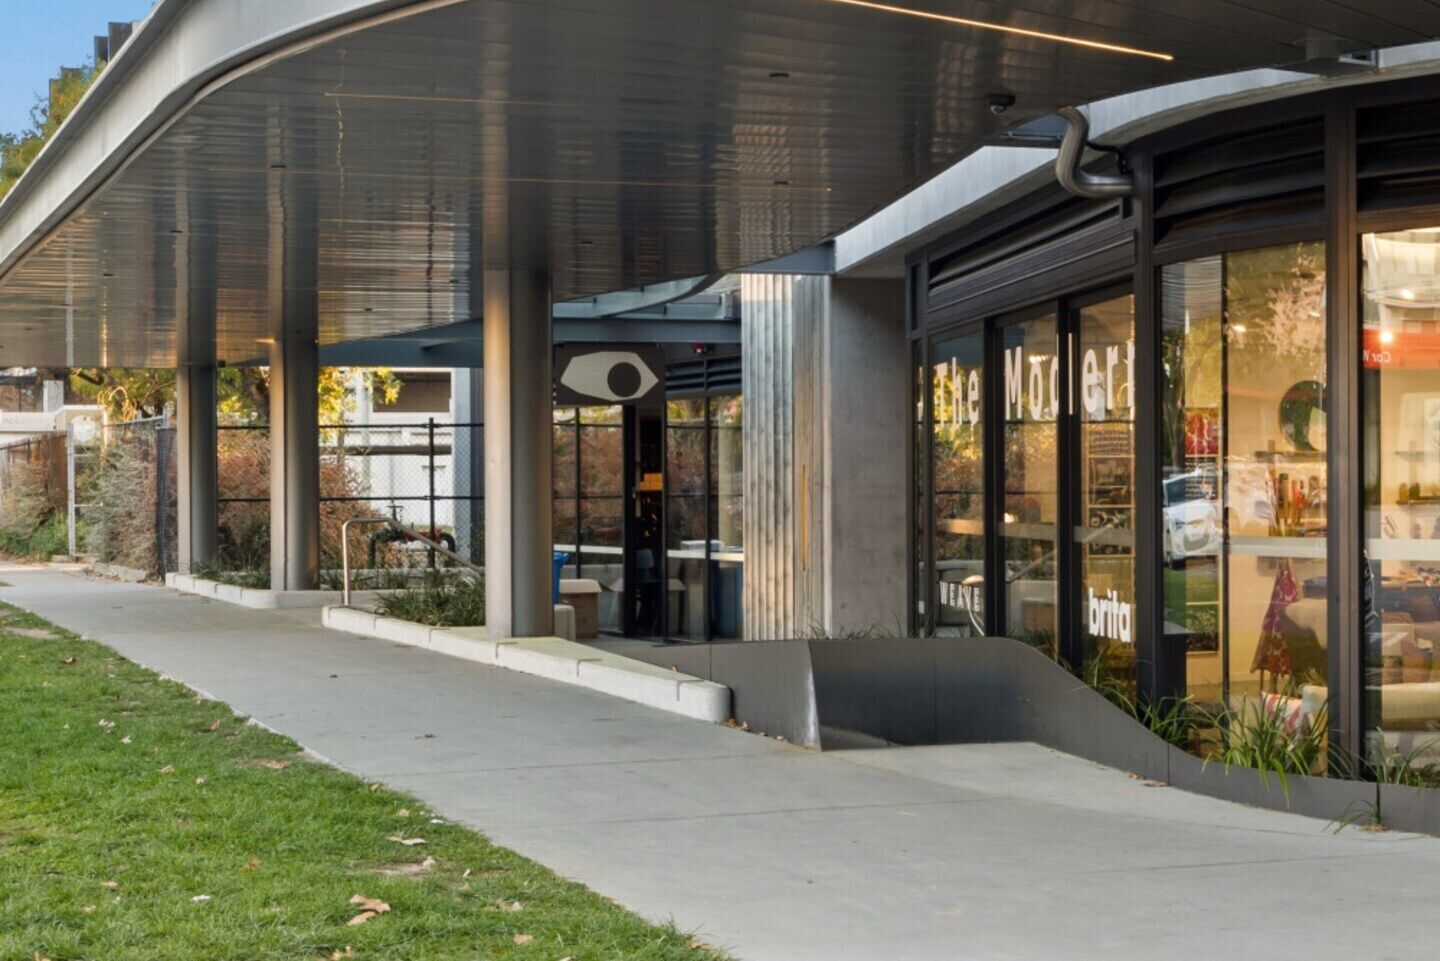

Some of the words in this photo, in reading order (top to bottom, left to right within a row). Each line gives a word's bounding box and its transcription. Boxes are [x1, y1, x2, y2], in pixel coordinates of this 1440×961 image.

[934, 356, 979, 428] The
[940, 581, 980, 613] WEAVE
[1088, 587, 1132, 643] brita
